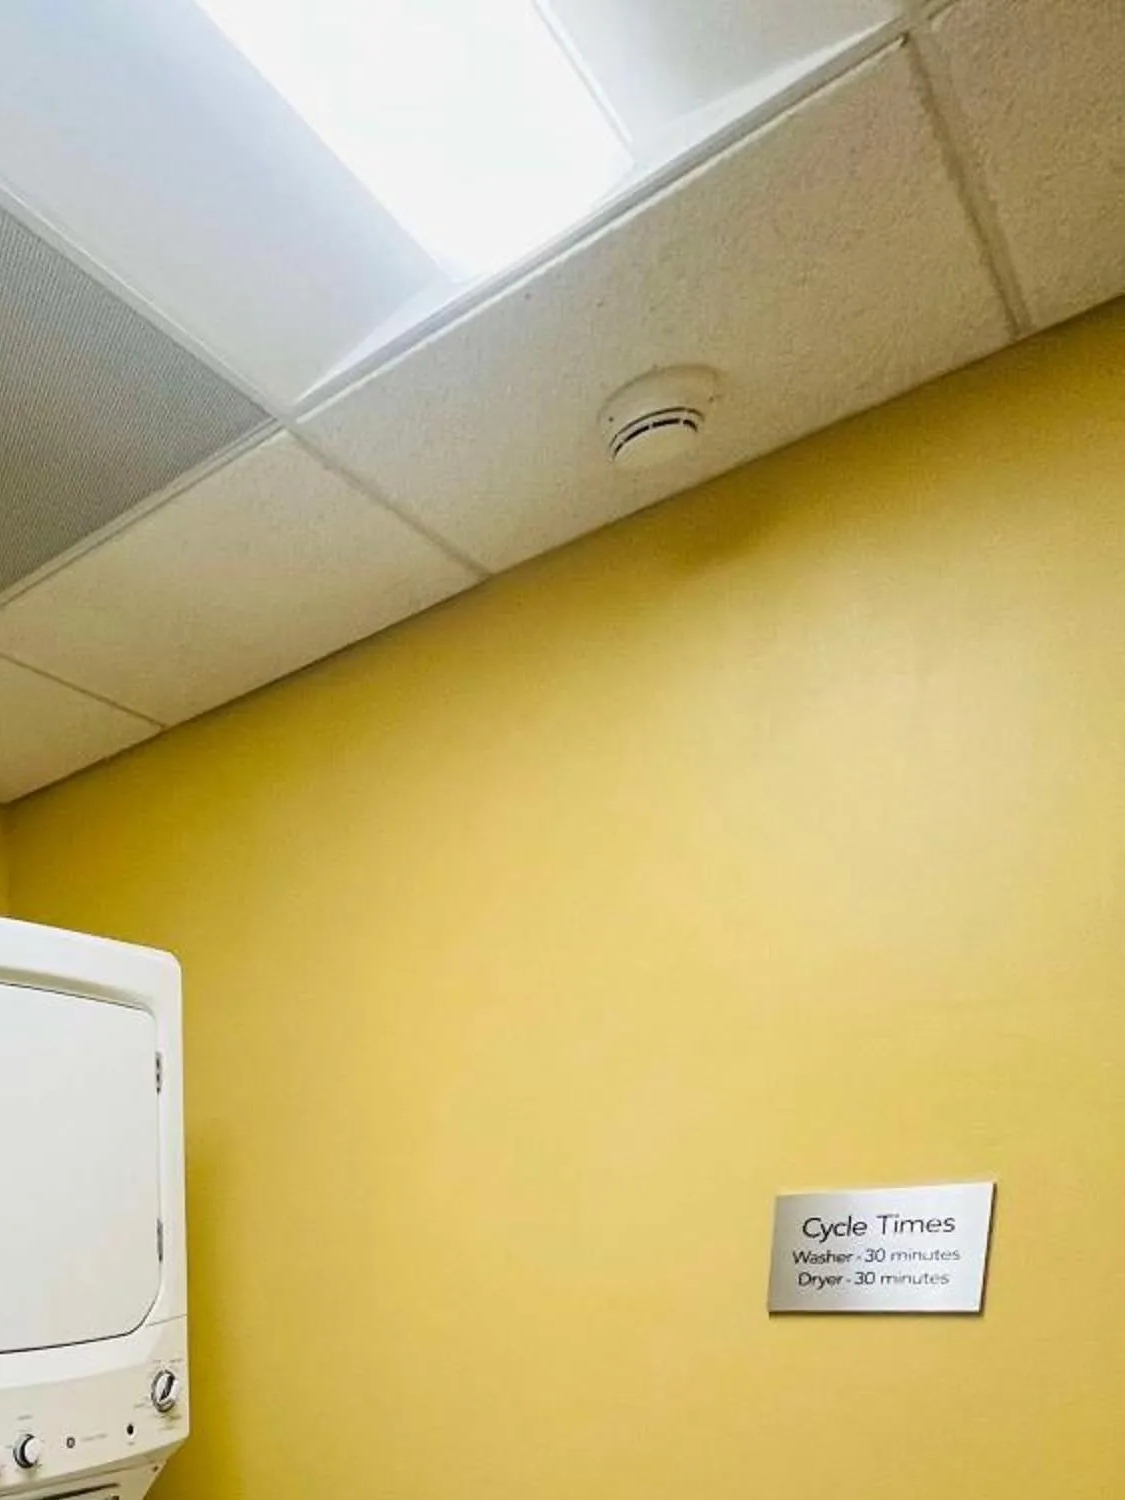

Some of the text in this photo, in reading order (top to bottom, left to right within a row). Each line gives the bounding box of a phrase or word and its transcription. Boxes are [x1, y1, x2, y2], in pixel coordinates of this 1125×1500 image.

[801, 1213, 956, 1243] Cycle Times
[792, 1249, 853, 1266] Washer
[864, 1247, 886, 1263] 30
[890, 1247, 961, 1262] minutes
[798, 1271, 844, 1290] Dryer
[854, 1271, 876, 1286] 30
[879, 1271, 951, 1286] minutes
